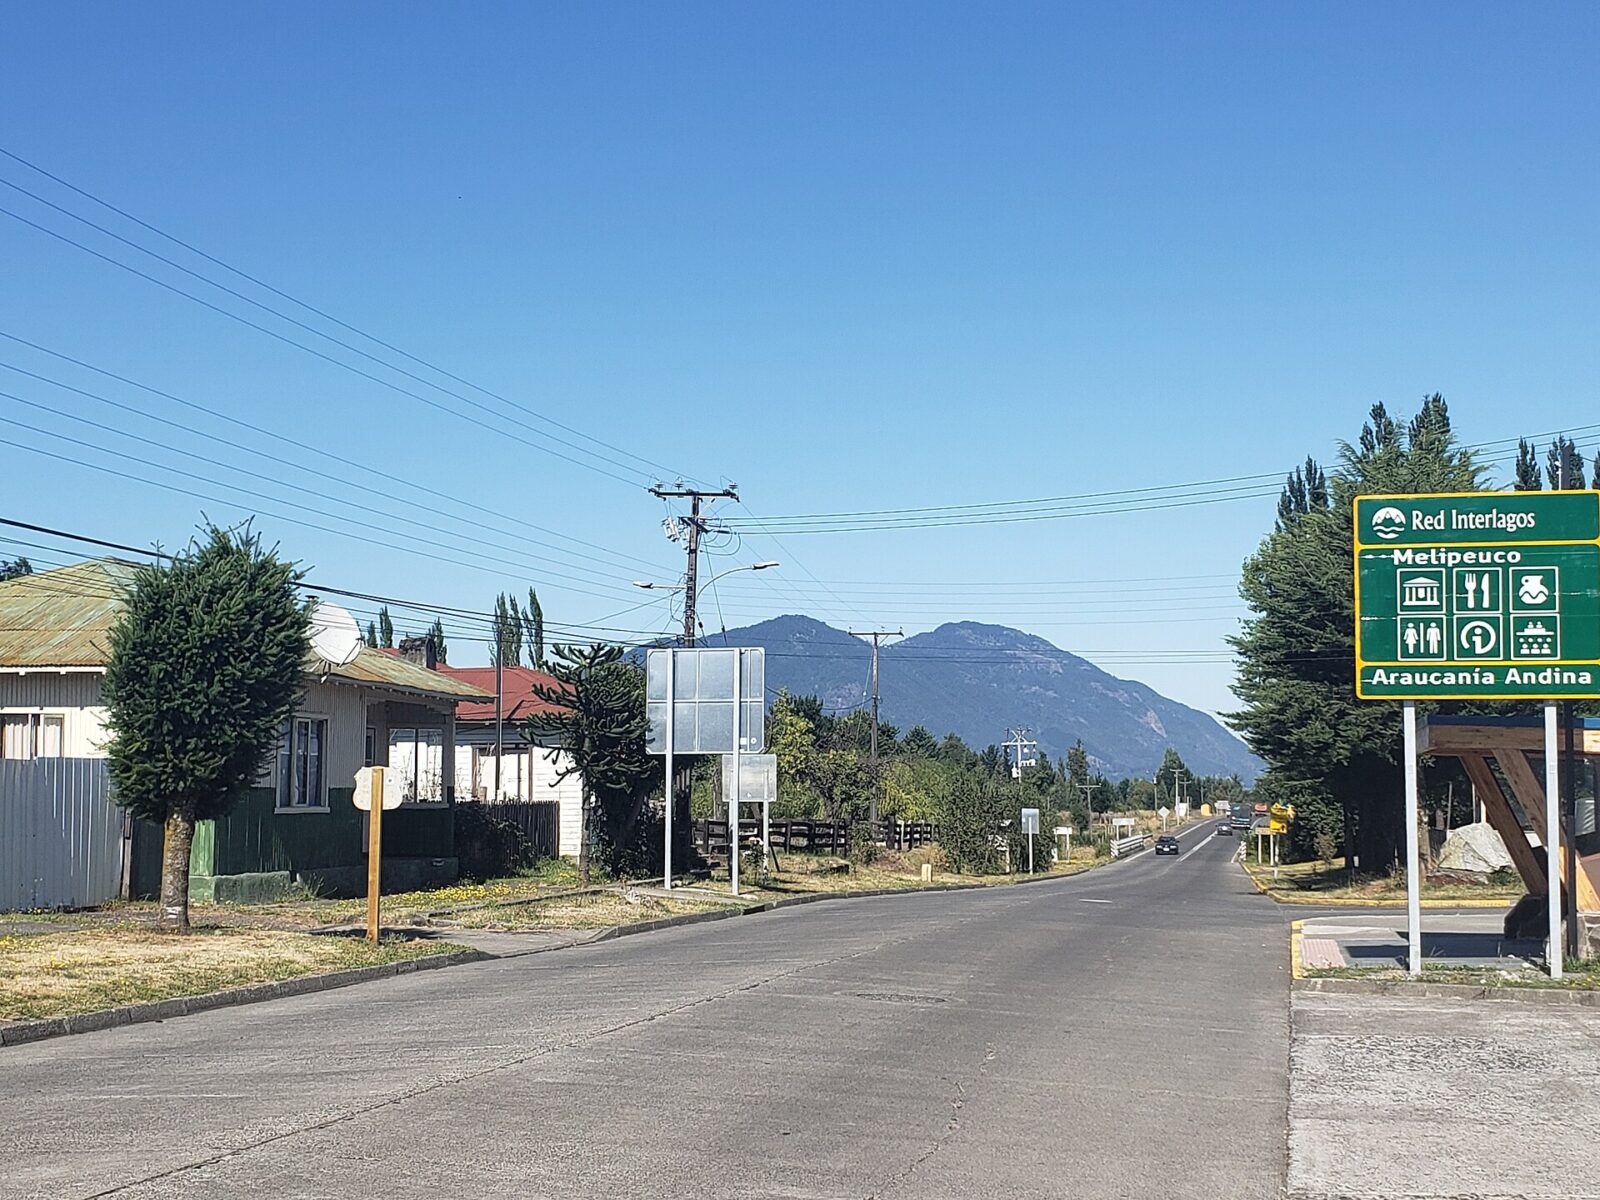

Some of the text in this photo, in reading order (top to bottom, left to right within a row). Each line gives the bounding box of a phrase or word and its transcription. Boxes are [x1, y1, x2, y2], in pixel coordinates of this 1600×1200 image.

[1411, 508, 1537, 533] Red Interlagos
[1392, 547, 1522, 568] Melipeuco
[1371, 667, 1593, 686] Araucanía Andina
